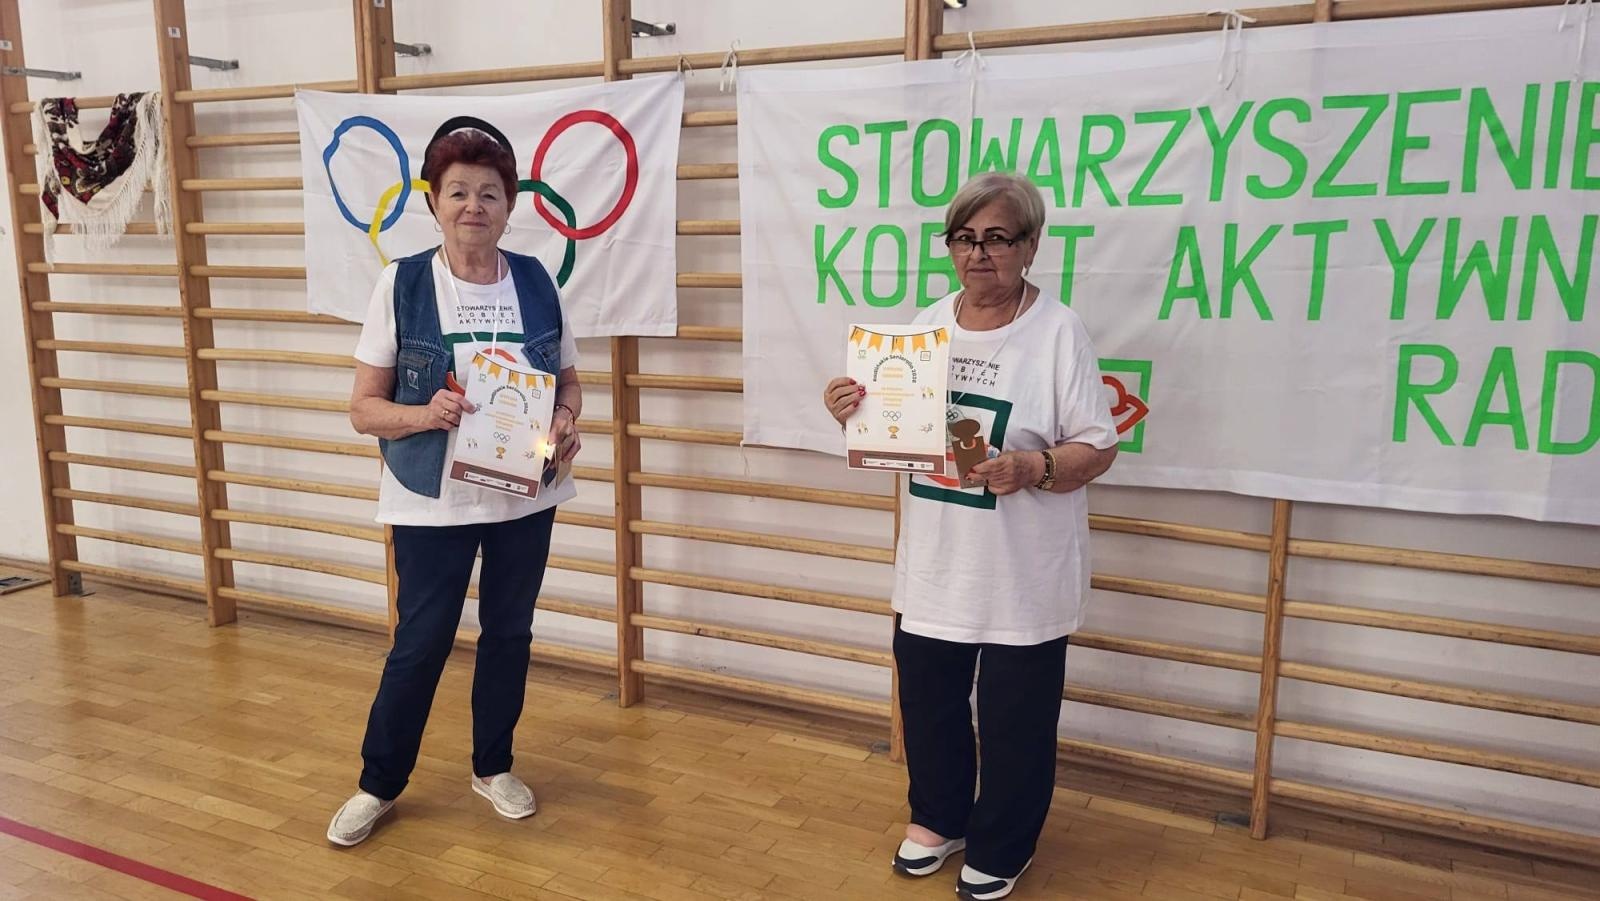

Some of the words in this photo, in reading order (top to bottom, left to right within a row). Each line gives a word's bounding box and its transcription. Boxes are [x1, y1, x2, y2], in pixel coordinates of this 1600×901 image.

[814, 222, 1095, 308] KOBT
[456, 304, 513, 312] STOWARZYSENIE
[951, 357, 1001, 371] WARZYSZNIE
